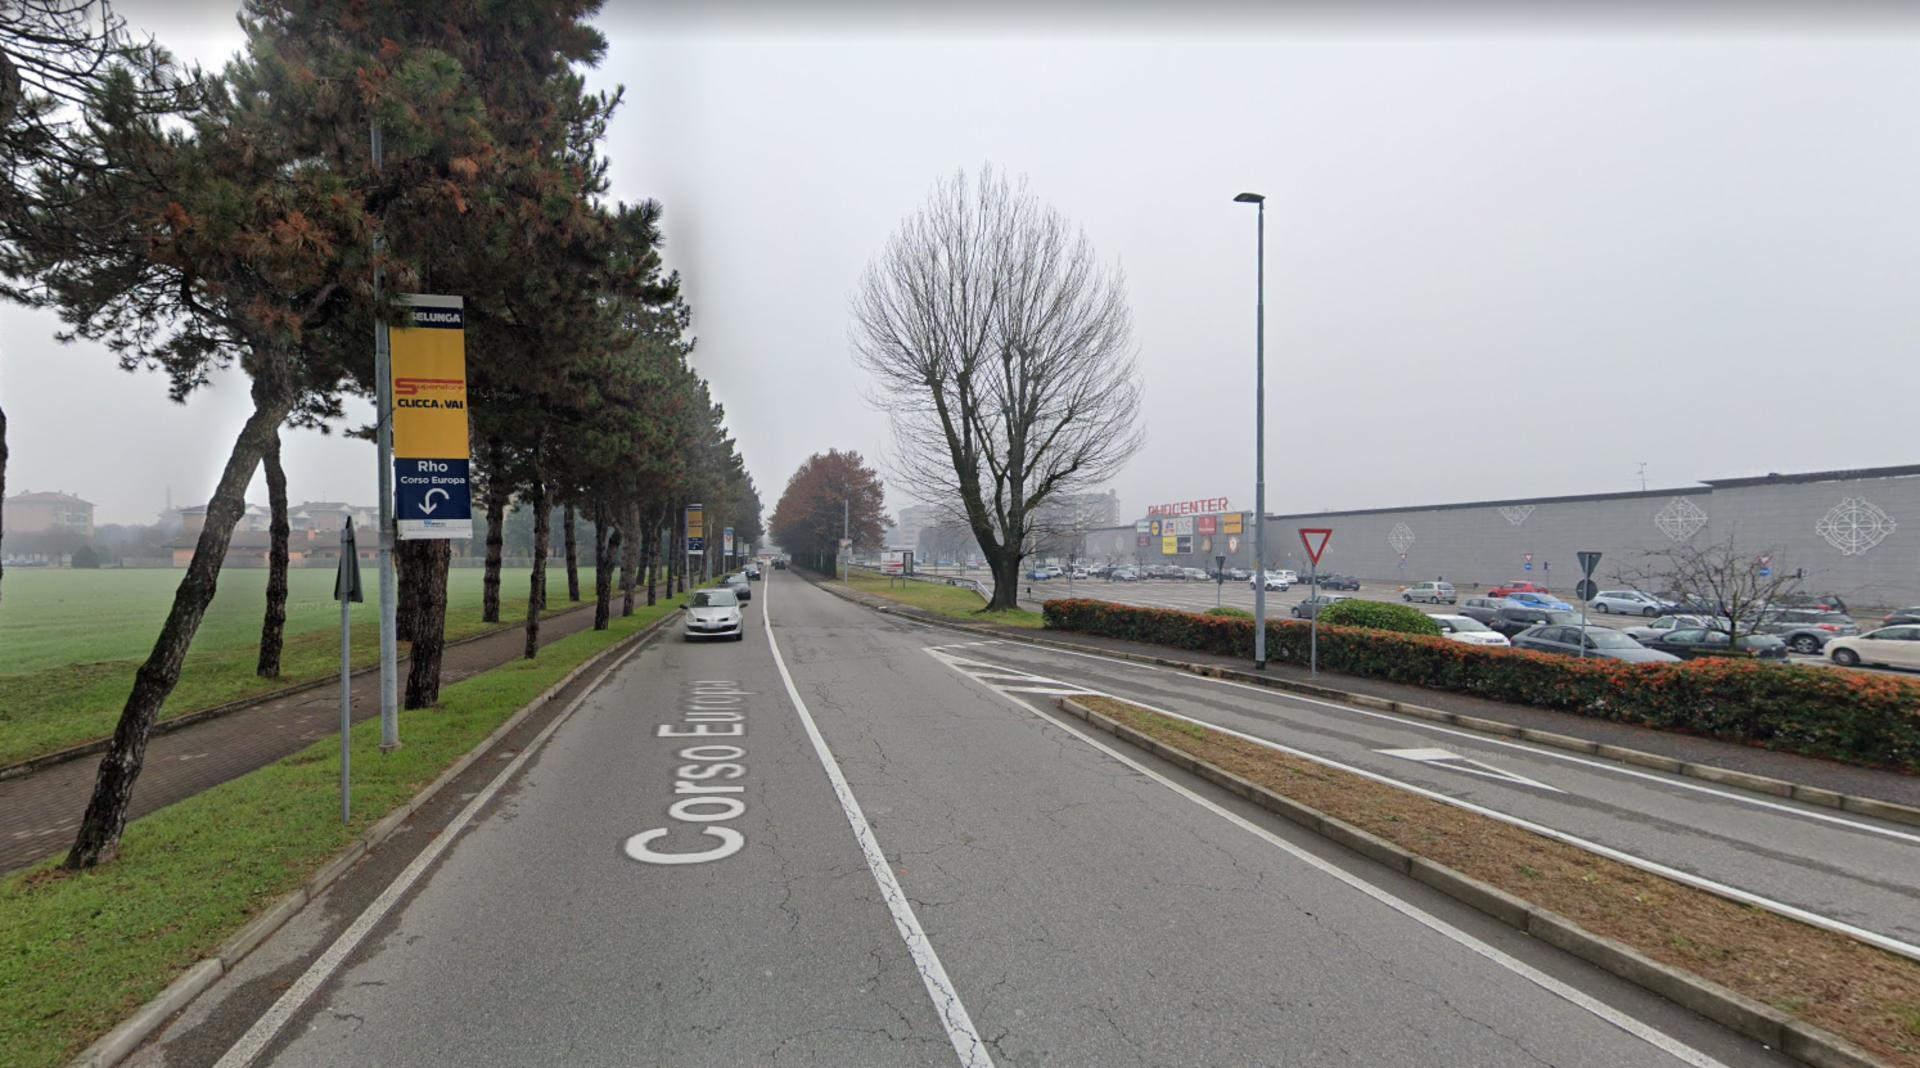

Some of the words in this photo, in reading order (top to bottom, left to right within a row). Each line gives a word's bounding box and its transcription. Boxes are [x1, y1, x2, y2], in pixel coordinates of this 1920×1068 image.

[412, 312, 461, 323] SELUNGA
[398, 399, 439, 408] CLICCA
[444, 400, 464, 409] VAI
[418, 460, 448, 472] Rho
[400, 476, 430, 484] Corso
[431, 476, 466, 485] Europa
